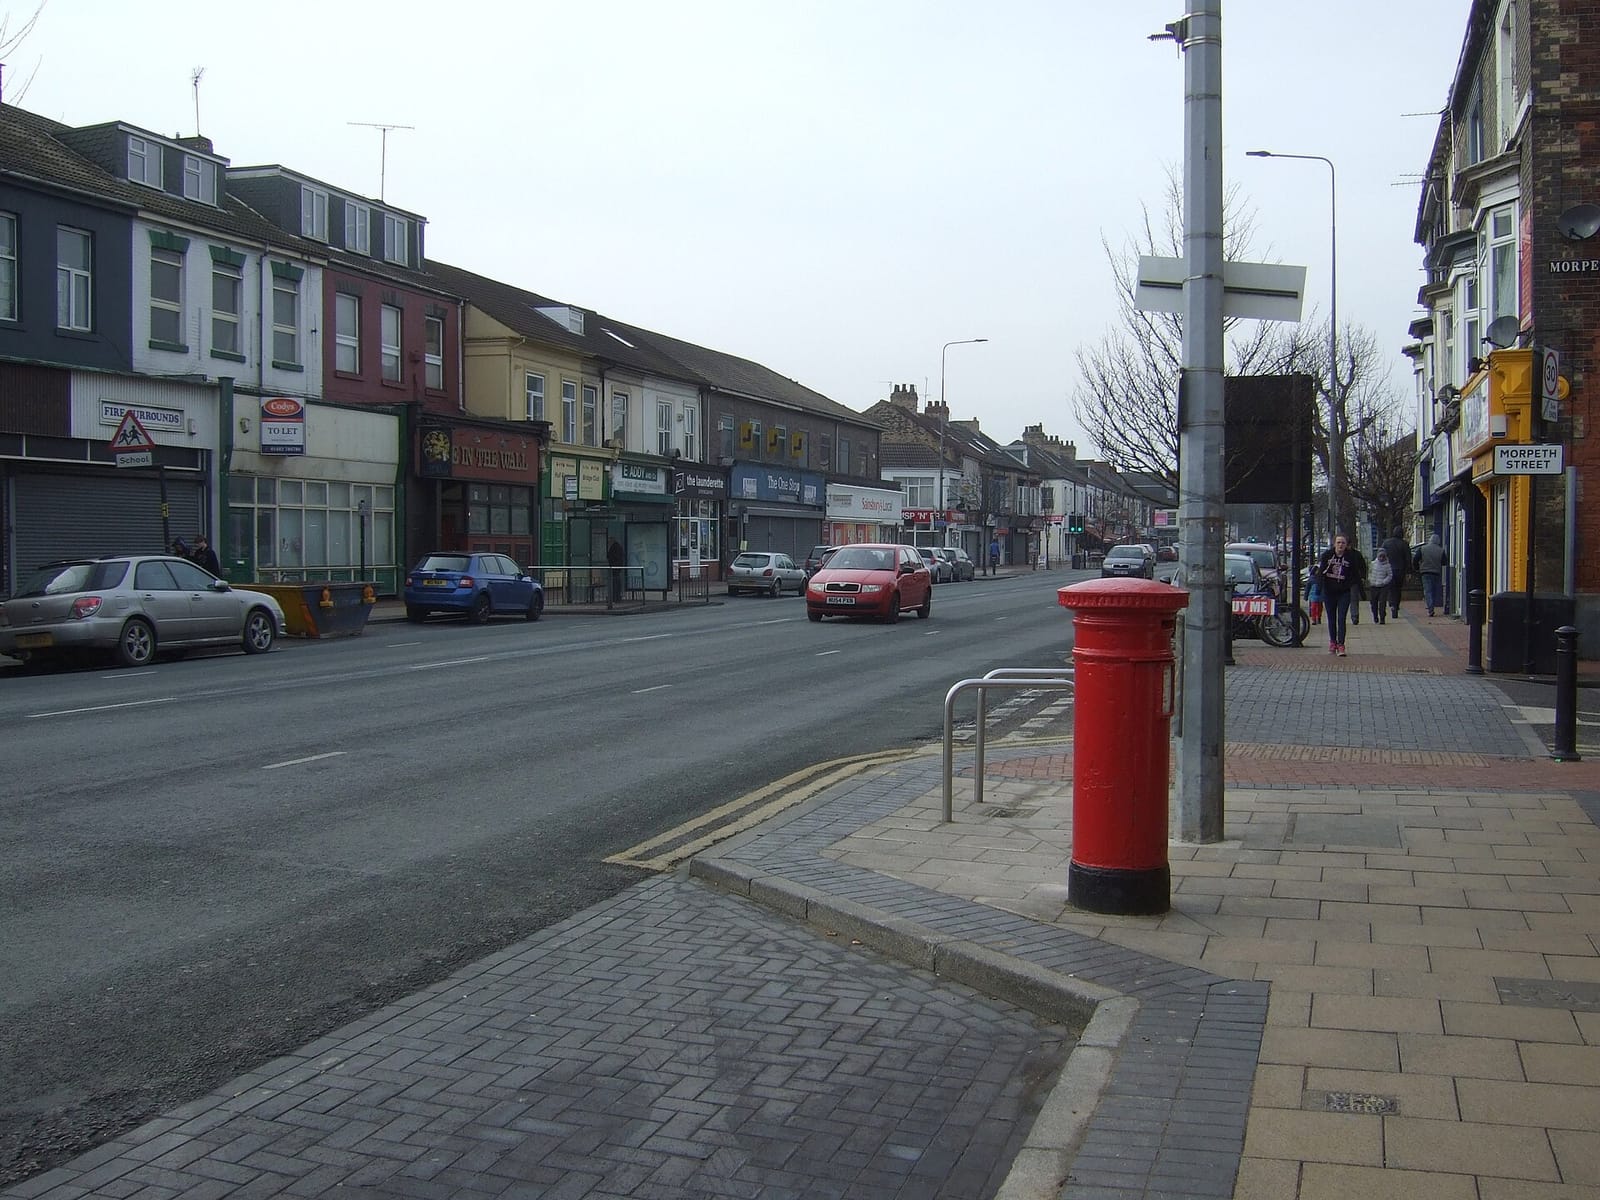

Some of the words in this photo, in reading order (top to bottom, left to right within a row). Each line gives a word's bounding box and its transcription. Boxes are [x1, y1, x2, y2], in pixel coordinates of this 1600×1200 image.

[1550, 261, 1600, 273] MORPE
[1546, 365, 1556, 382] 30
[271, 401, 295, 412] Codys
[104, 406, 125, 417] FIRE
[132, 410, 180, 424] URROUNDS
[268, 427, 280, 435] TO
[282, 427, 299, 435] LET
[119, 455, 150, 465] School
[461, 447, 474, 466] IN
[476, 448, 498, 468] THE
[500, 451, 529, 470] WALL
[1500, 449, 1557, 459] MORPETH
[1506, 460, 1550, 469] STREET
[686, 474, 696, 486] the
[768, 475, 777, 489] The
[778, 477, 788, 490] One
[789, 478, 800, 495] Stop
[1250, 601, 1268, 613] ME
